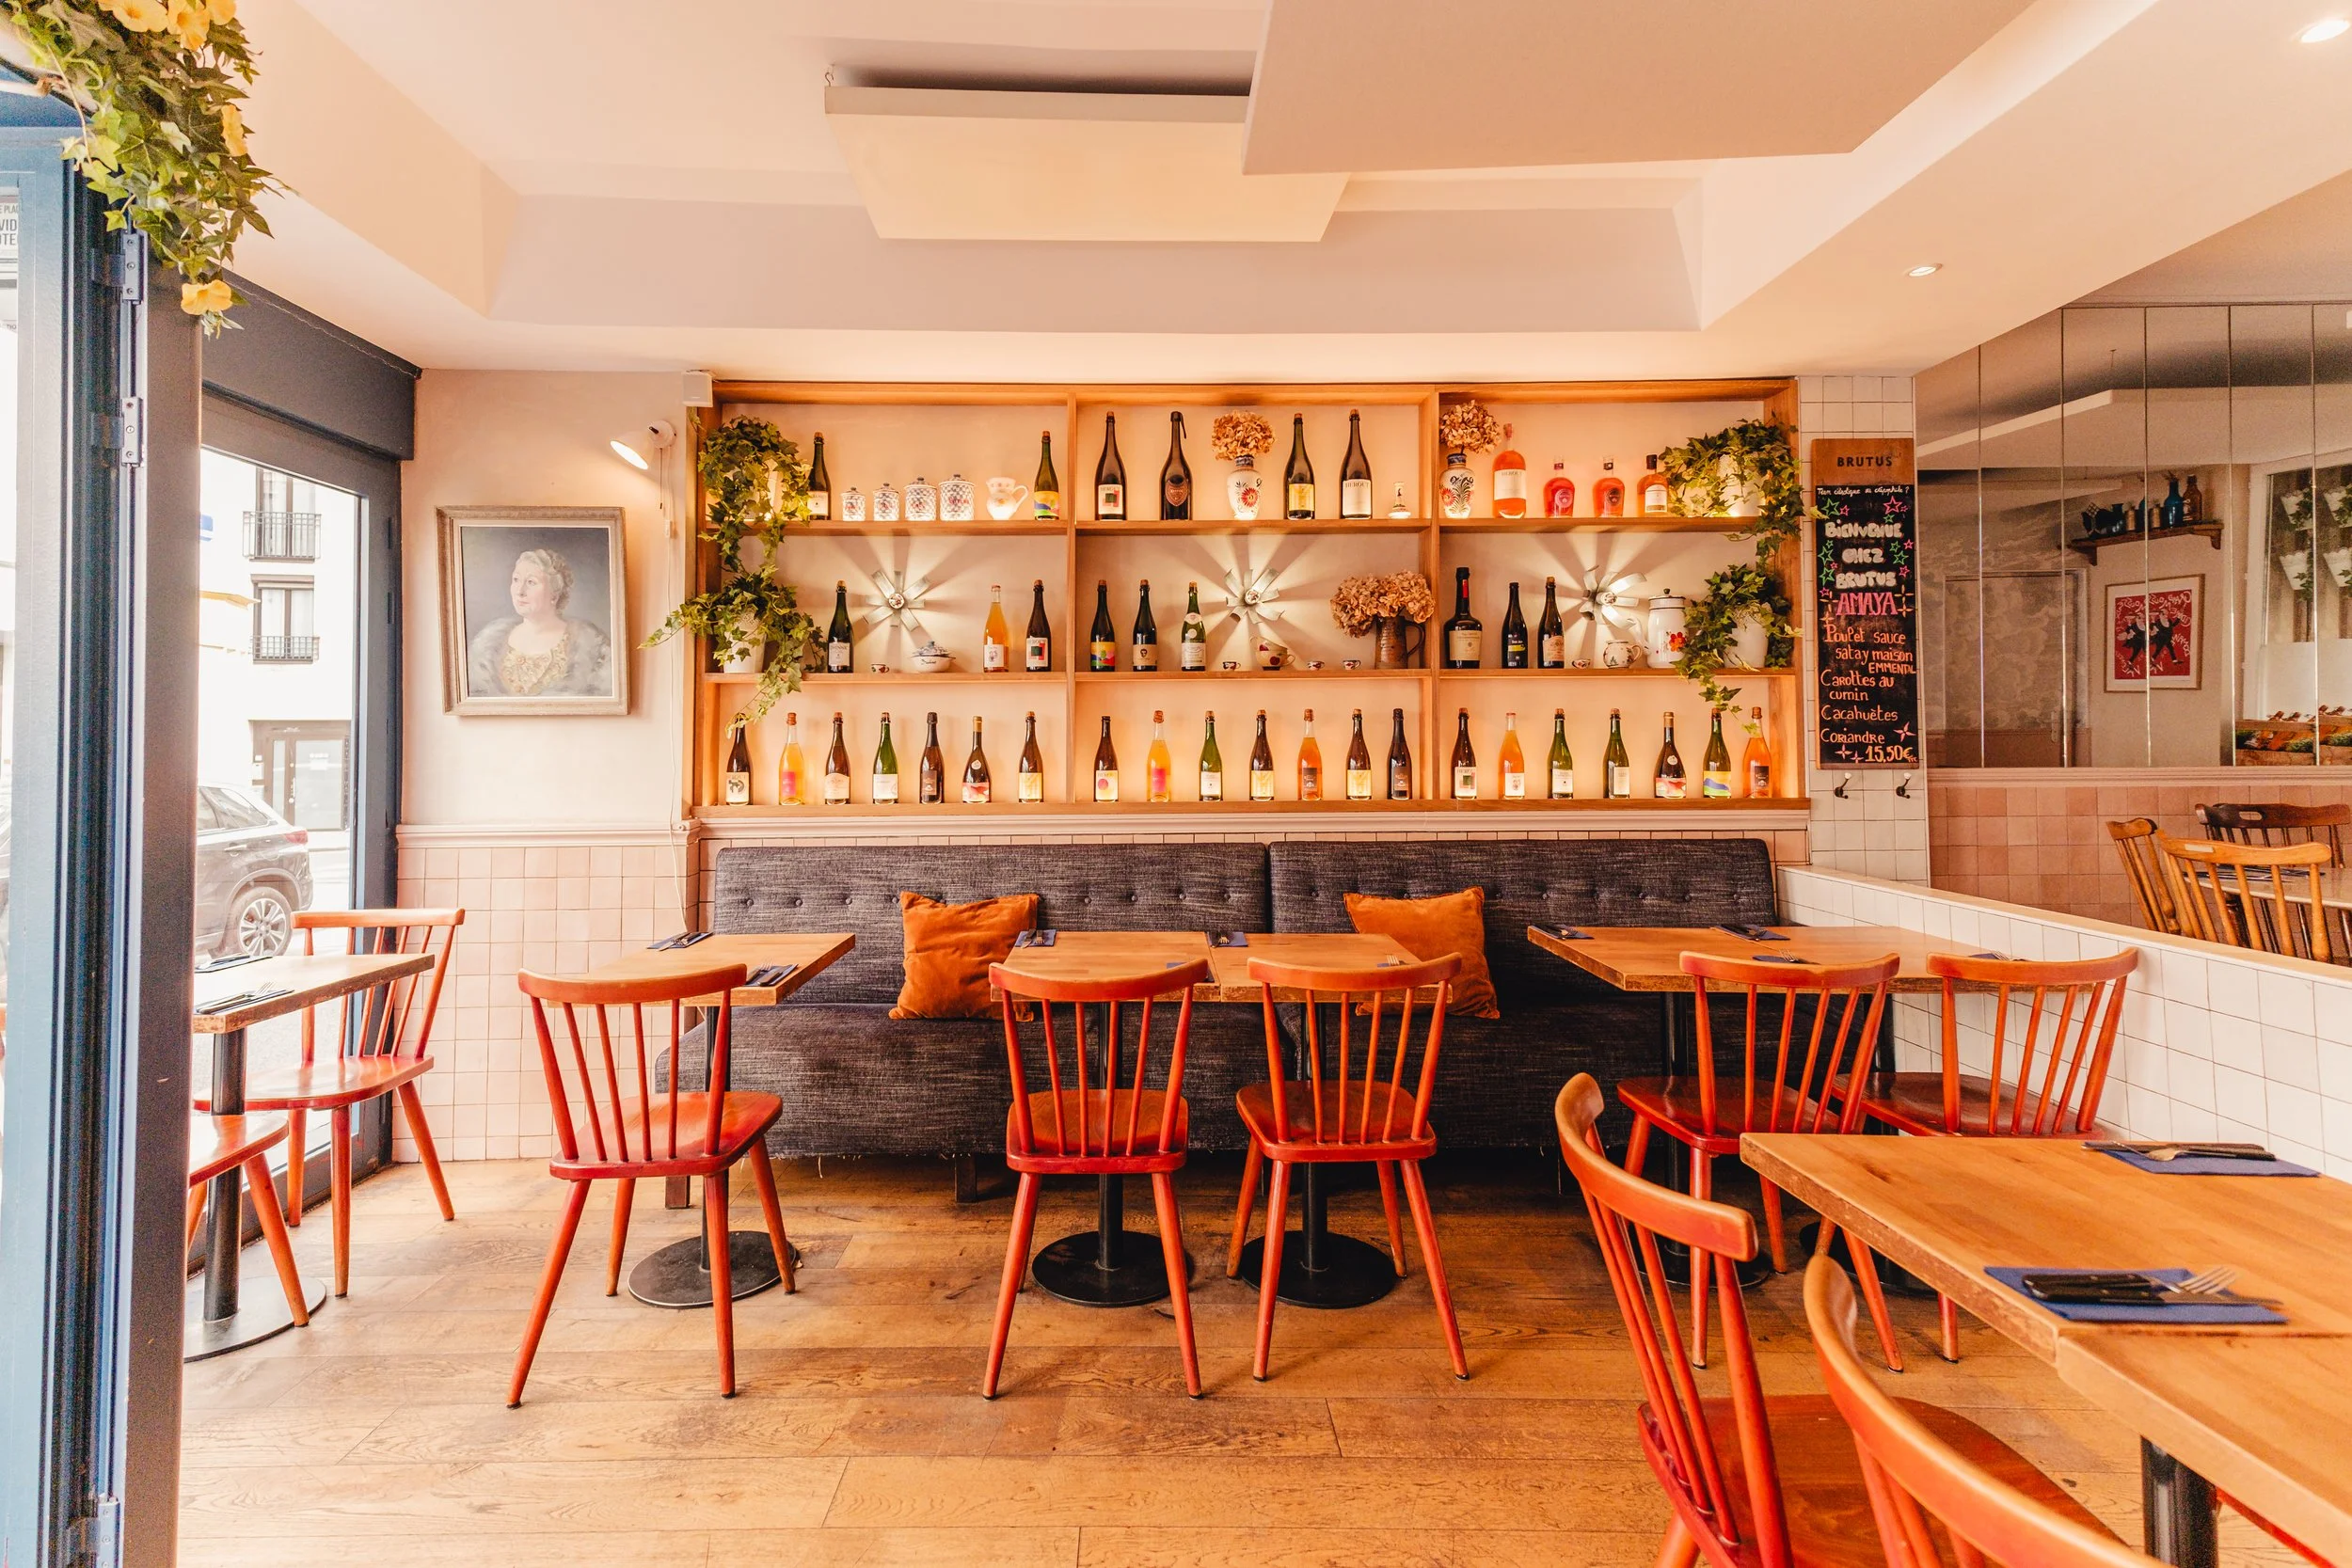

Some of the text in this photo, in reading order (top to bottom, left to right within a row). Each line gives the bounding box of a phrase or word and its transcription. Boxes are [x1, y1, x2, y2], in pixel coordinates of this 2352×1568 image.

[1836, 456, 1893, 467] BRUTUS
[1841, 547, 1884, 563] CHEZ
[1836, 571, 1897, 590] BRUTUS
[1836, 592, 1899, 616] AMAYA
[1823, 623, 1906, 645] Poulet sauce
[1836, 644, 1913, 666] satay maison
[1868, 661, 1916, 674] EMMENTAL
[1879, 675, 1895, 688] au
[1829, 688, 1868, 702] cumin
[1820, 705, 1899, 721] Cacahuètes
